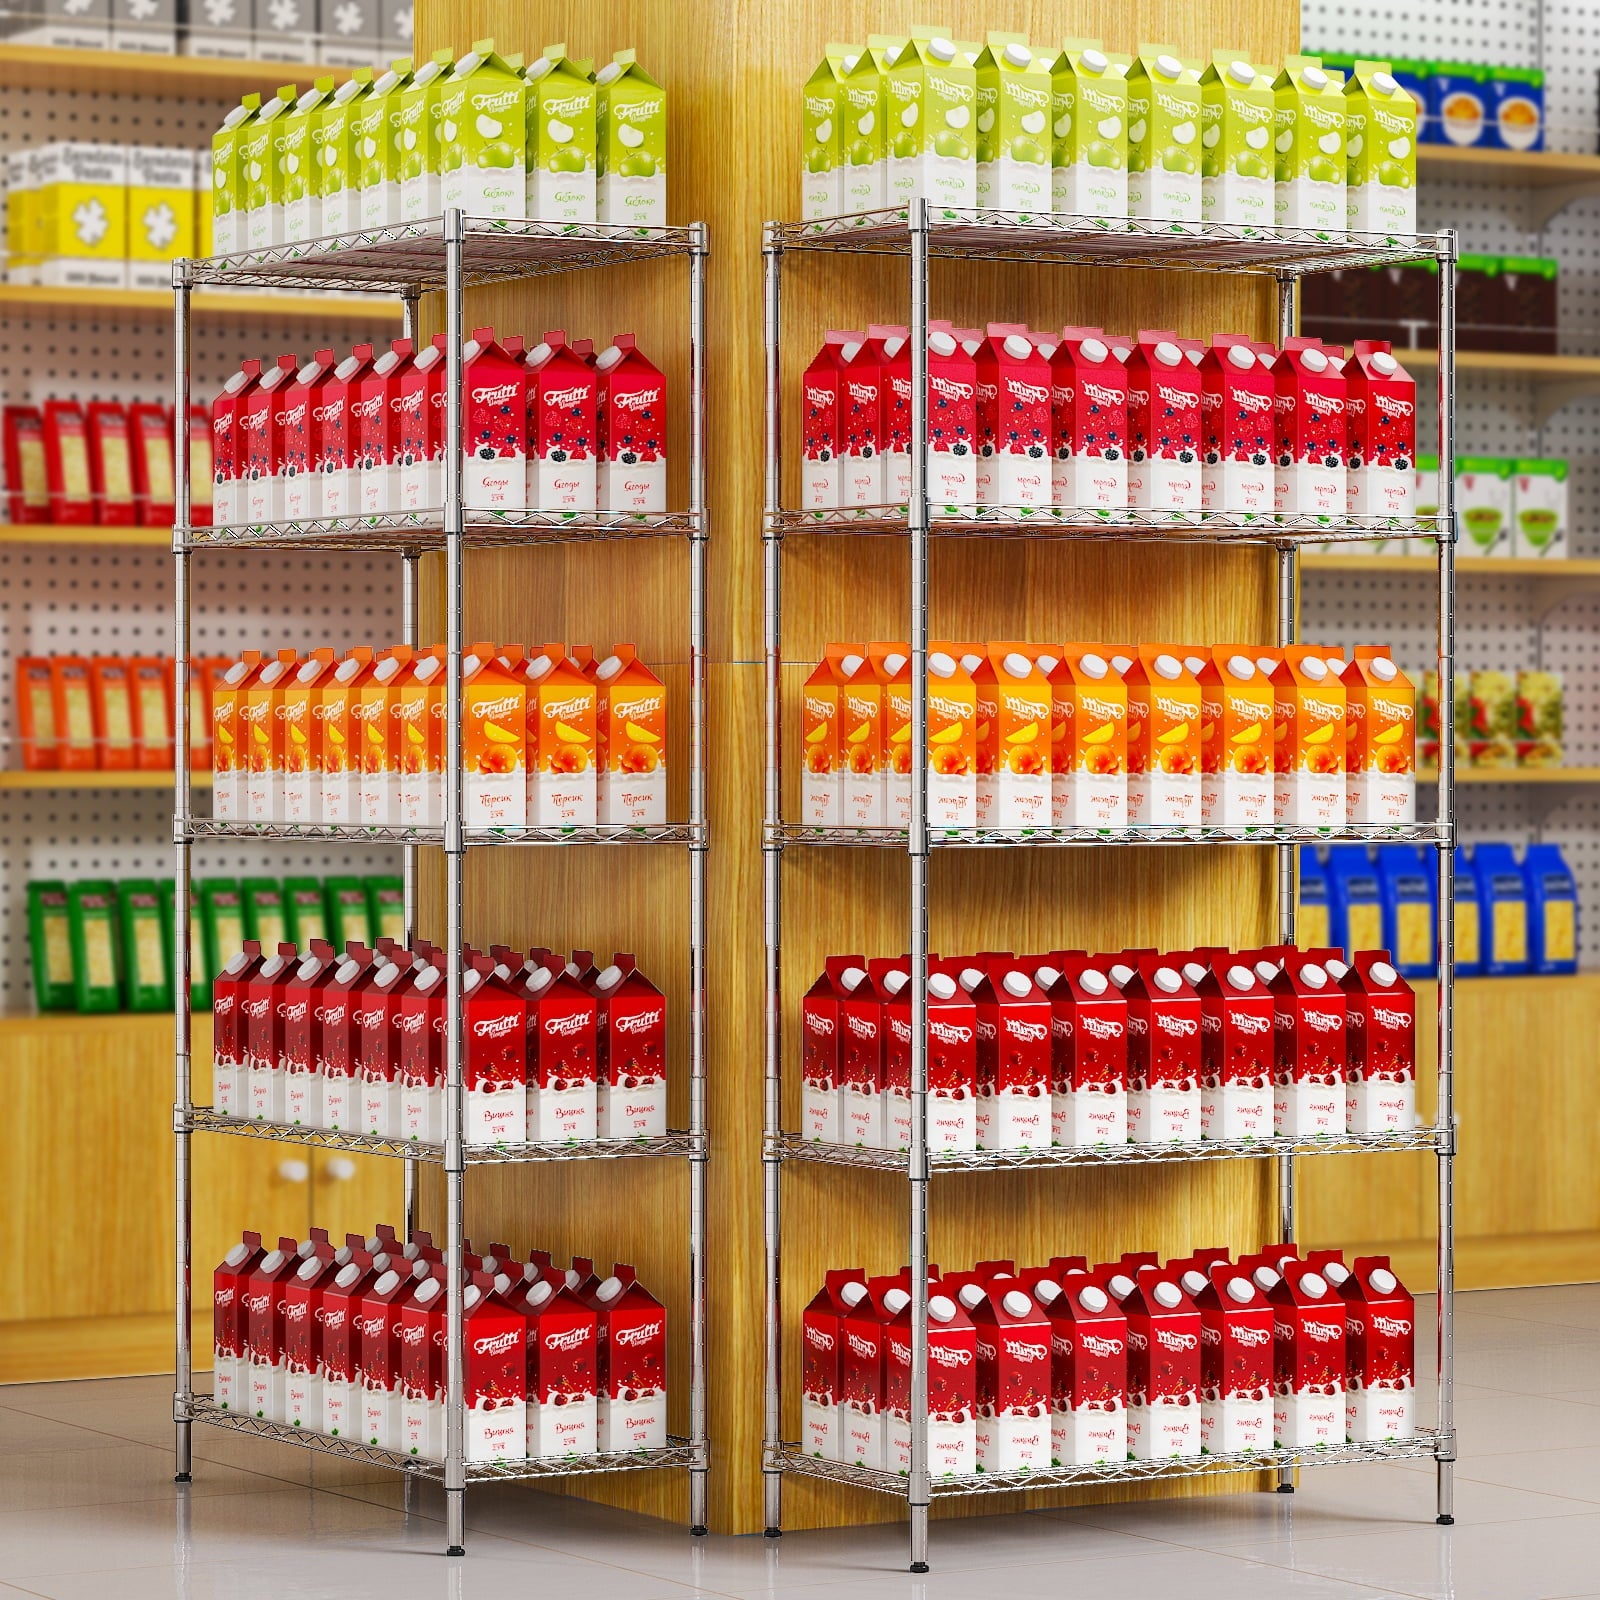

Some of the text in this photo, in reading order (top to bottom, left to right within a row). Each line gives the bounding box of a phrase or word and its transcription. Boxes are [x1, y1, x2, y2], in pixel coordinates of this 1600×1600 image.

[472, 91, 519, 110] Frutti
[543, 97, 590, 120] Frutti
[614, 101, 659, 124] Frutti
[472, 384, 517, 403] Frutti
[544, 387, 588, 406] Frutti
[614, 390, 658, 408] Frutti
[472, 697, 519, 718] Frutti
[543, 697, 590, 718] Frutti
[614, 698, 660, 718] Frutti
[474, 1015, 519, 1036] Frutti
[545, 1013, 589, 1034] Frutti
[616, 1011, 659, 1032] Frutti
[474, 1332, 519, 1354] Frutti
[546, 1327, 590, 1349] Frutti
[616, 1323, 659, 1345] Frutti
